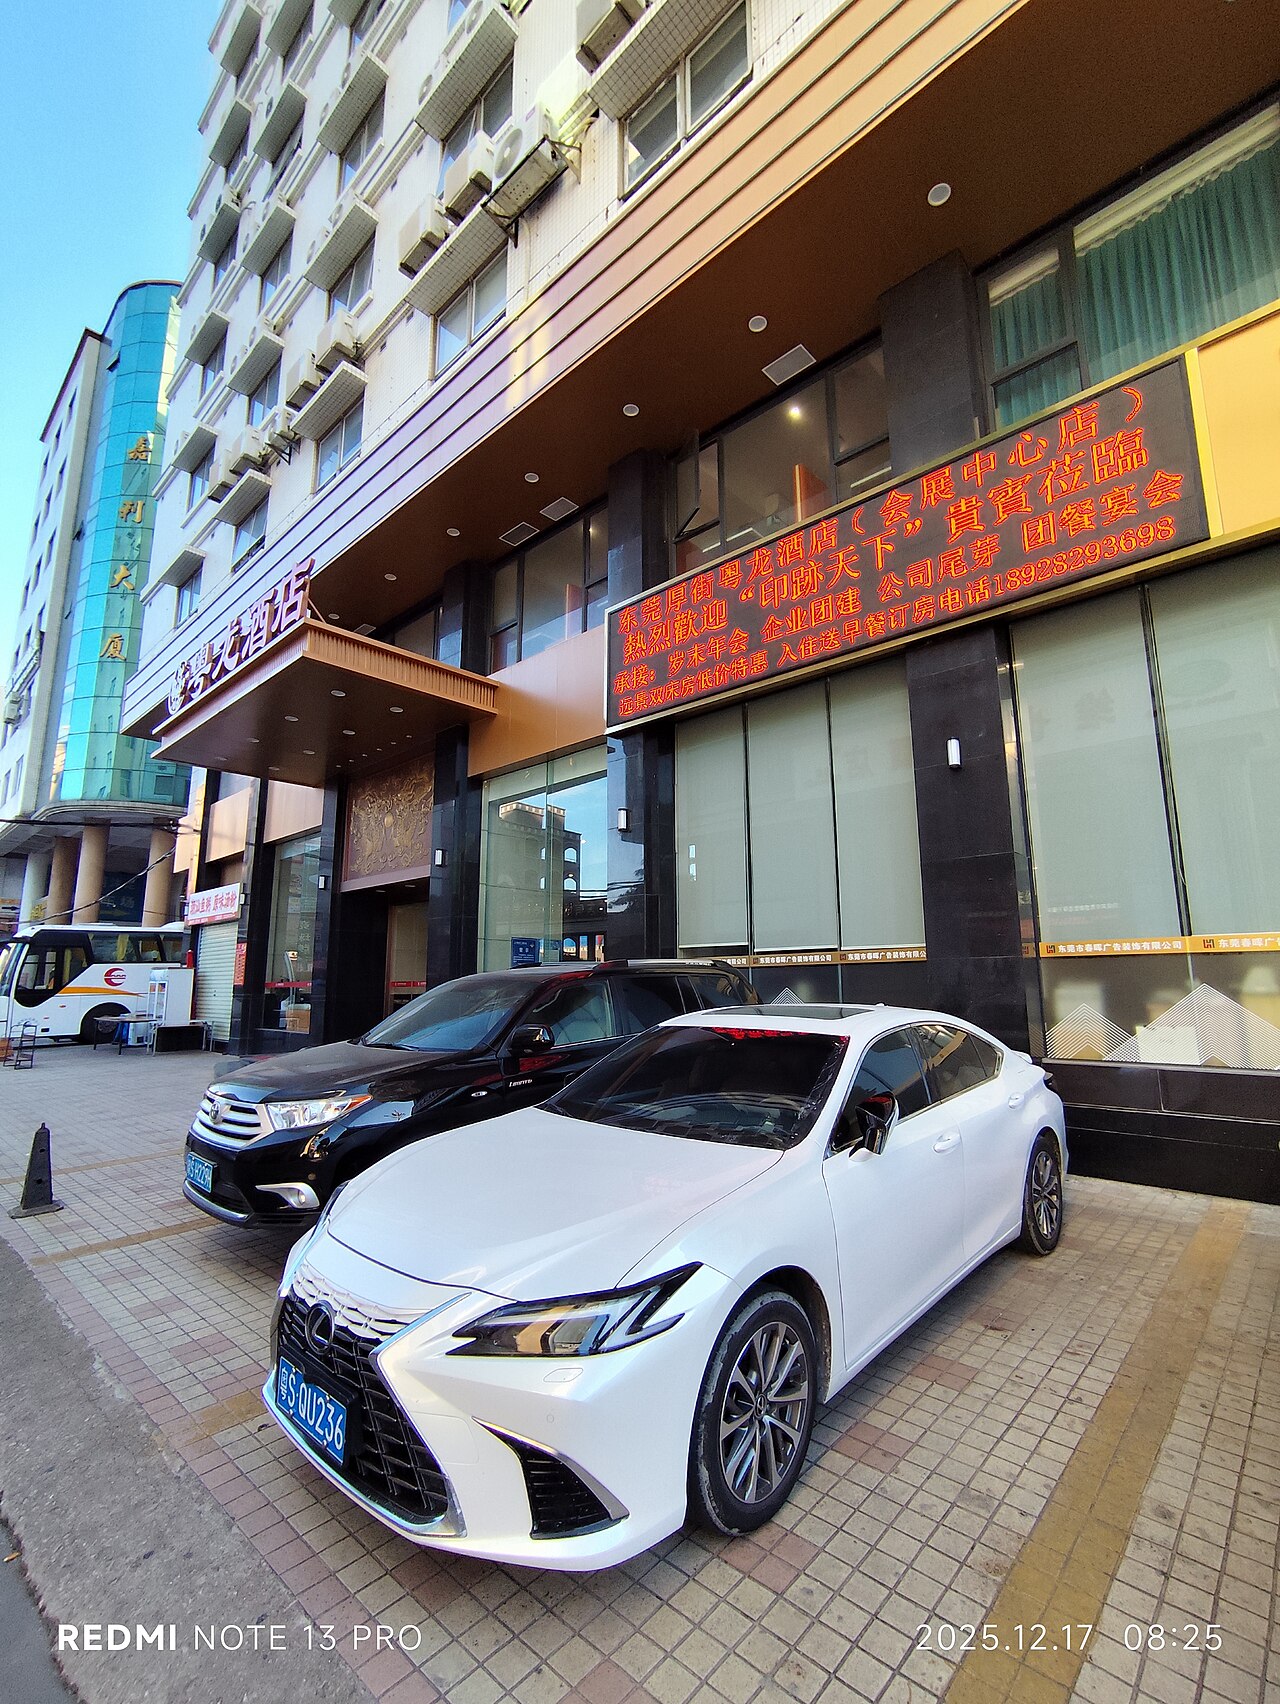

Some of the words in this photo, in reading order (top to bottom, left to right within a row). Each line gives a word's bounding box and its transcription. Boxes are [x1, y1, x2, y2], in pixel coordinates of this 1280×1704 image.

[667, 628, 749, 677] 岁末年会
[762, 586, 862, 643] 企业团建
[877, 534, 1001, 603] 公司尾芽
[1021, 469, 1184, 554] 团餐宴会
[1218, 937, 1280, 948] 东莞春晖广
